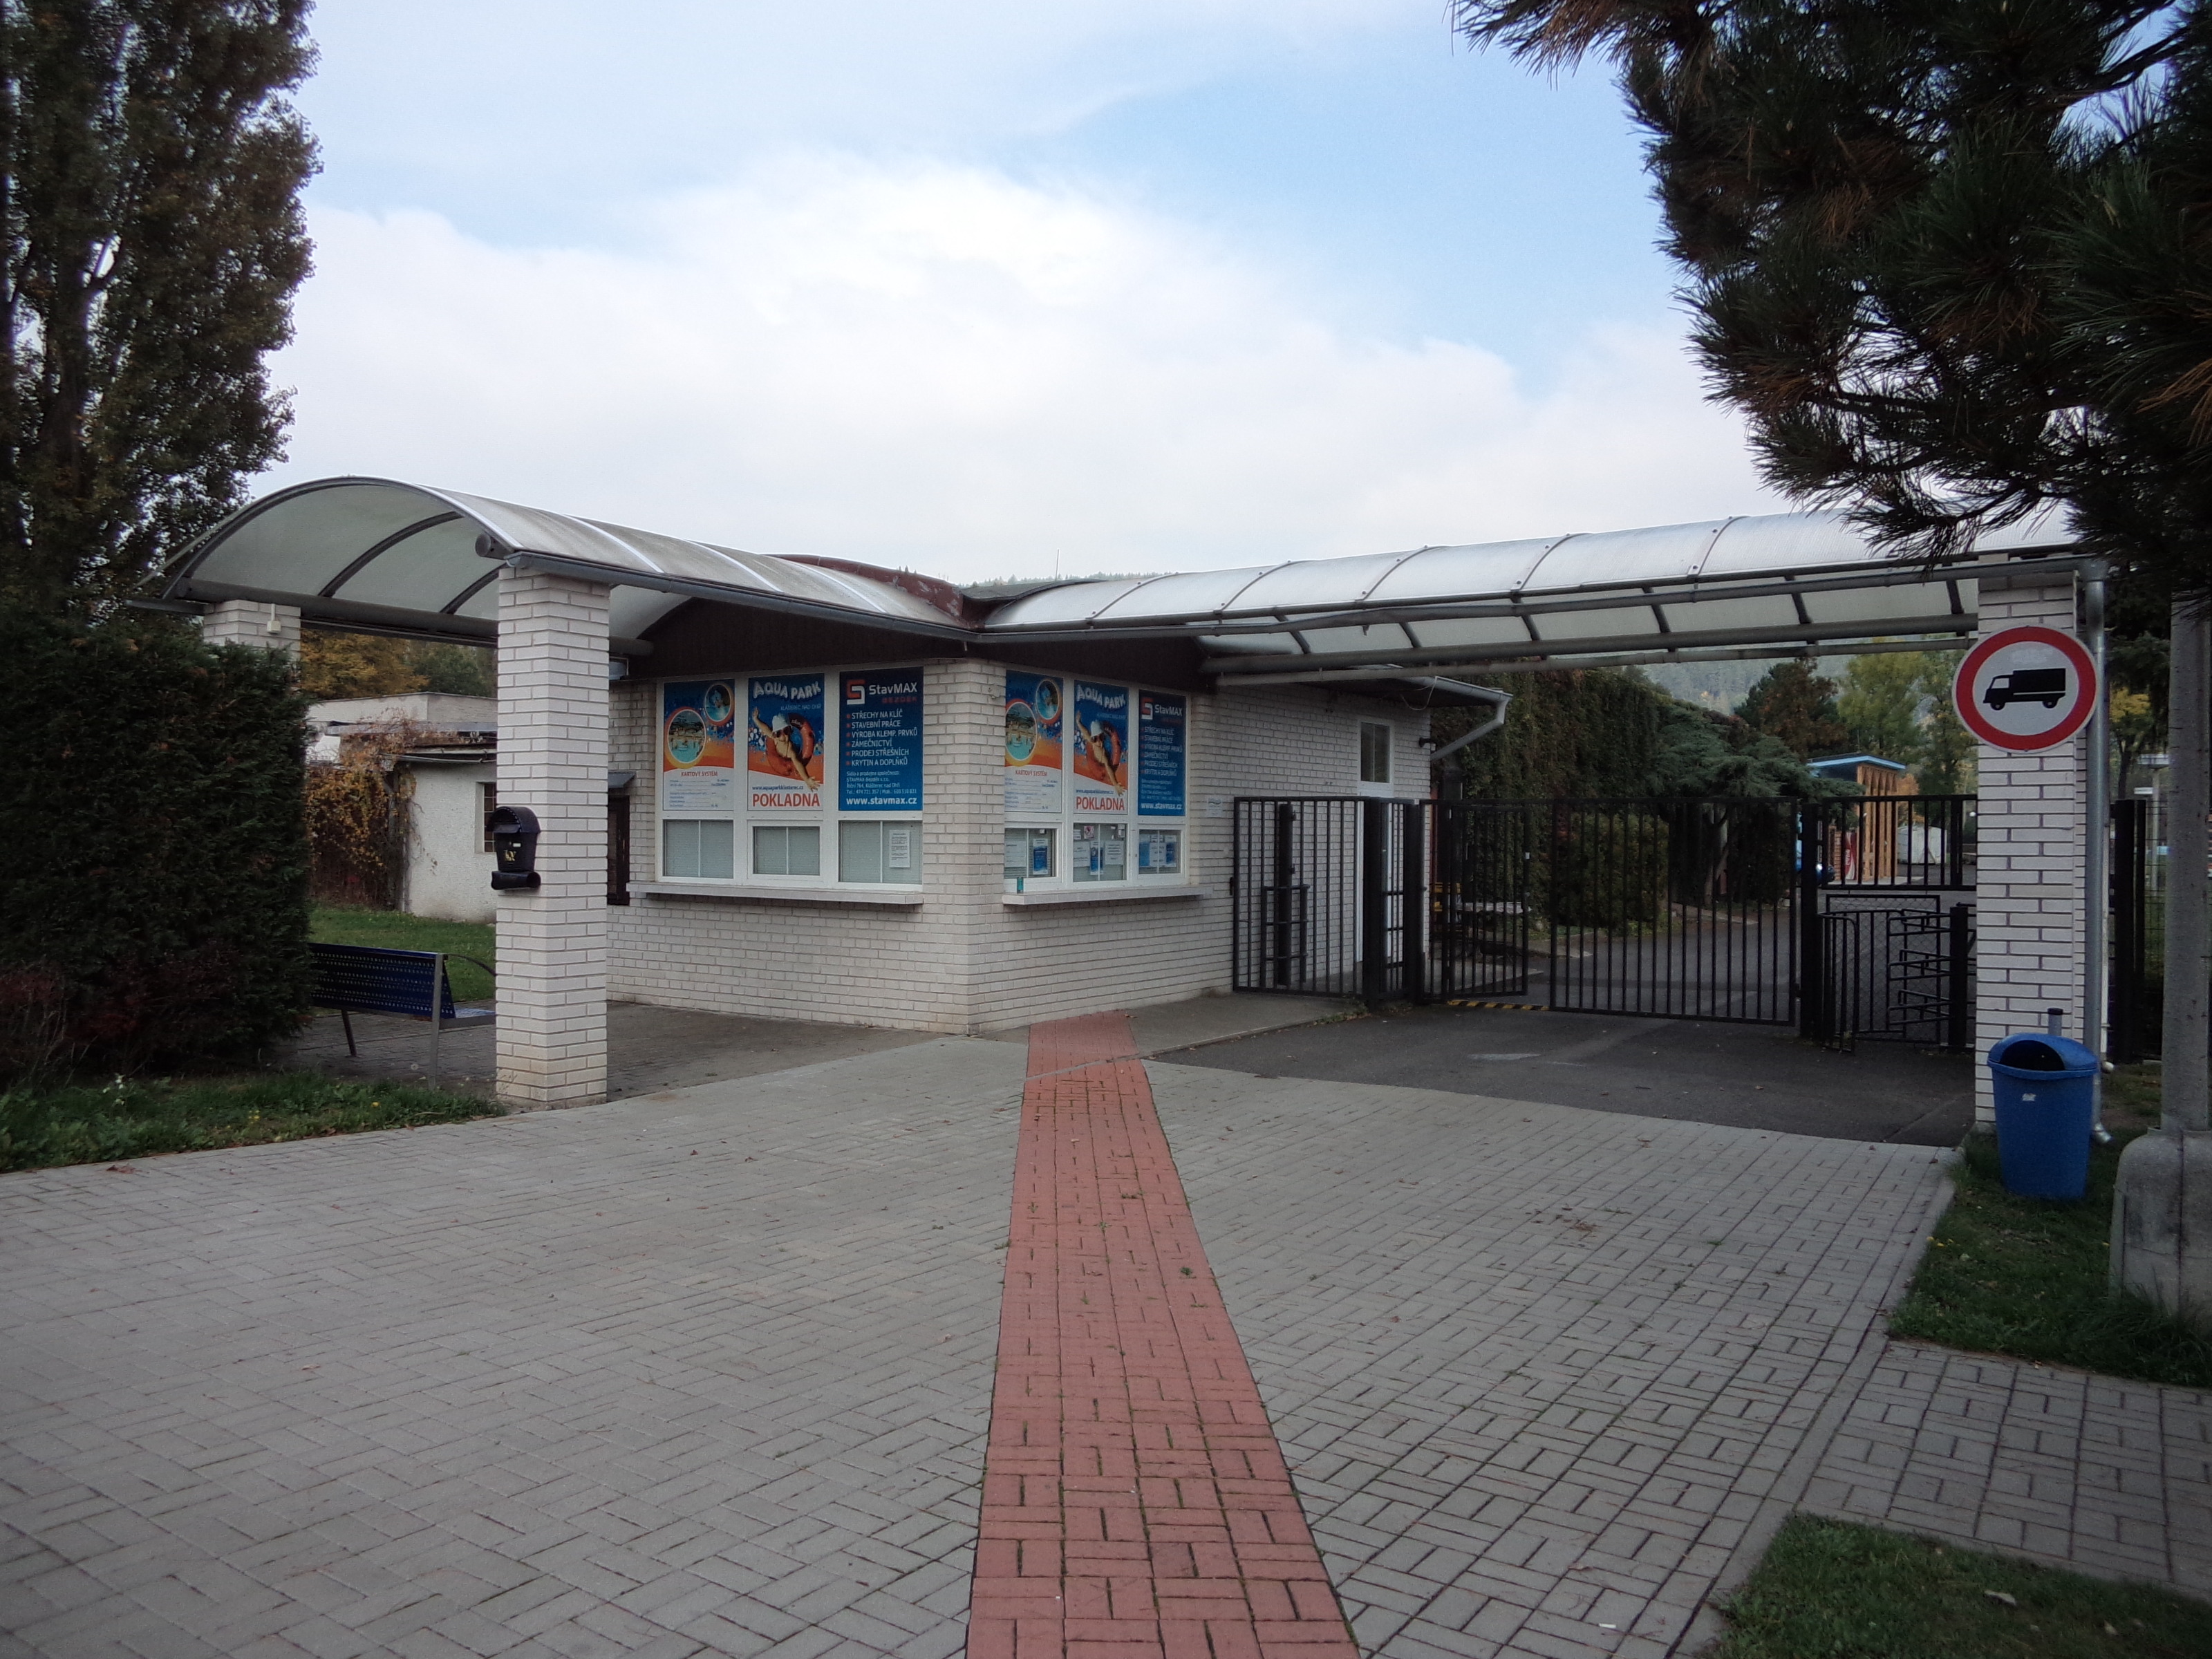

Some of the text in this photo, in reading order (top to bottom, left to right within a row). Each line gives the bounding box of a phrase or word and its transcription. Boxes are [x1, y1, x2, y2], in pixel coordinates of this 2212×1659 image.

[753, 681, 821, 700] AQUA PARK
[869, 682, 917, 695] StavMAX
[1076, 684, 1125, 709] AQUA PARK
[852, 711, 879, 719] STŘECHY
[889, 709, 903, 718] KLÍČ
[1154, 704, 1182, 716] StavMAX
[852, 718, 901, 729] STAVEBNÍ PRÁCE
[852, 729, 874, 738] VÝROBA
[899, 727, 918, 736] PRVKŮ
[852, 738, 892, 747] ZÁMEČNICTVÍ
[875, 747, 909, 756] STŘEŠNÍCH
[880, 756, 908, 765] DOPLŇKŮ
[753, 793, 821, 807] POKLADNA
[1076, 796, 1125, 810] POKLADNA
